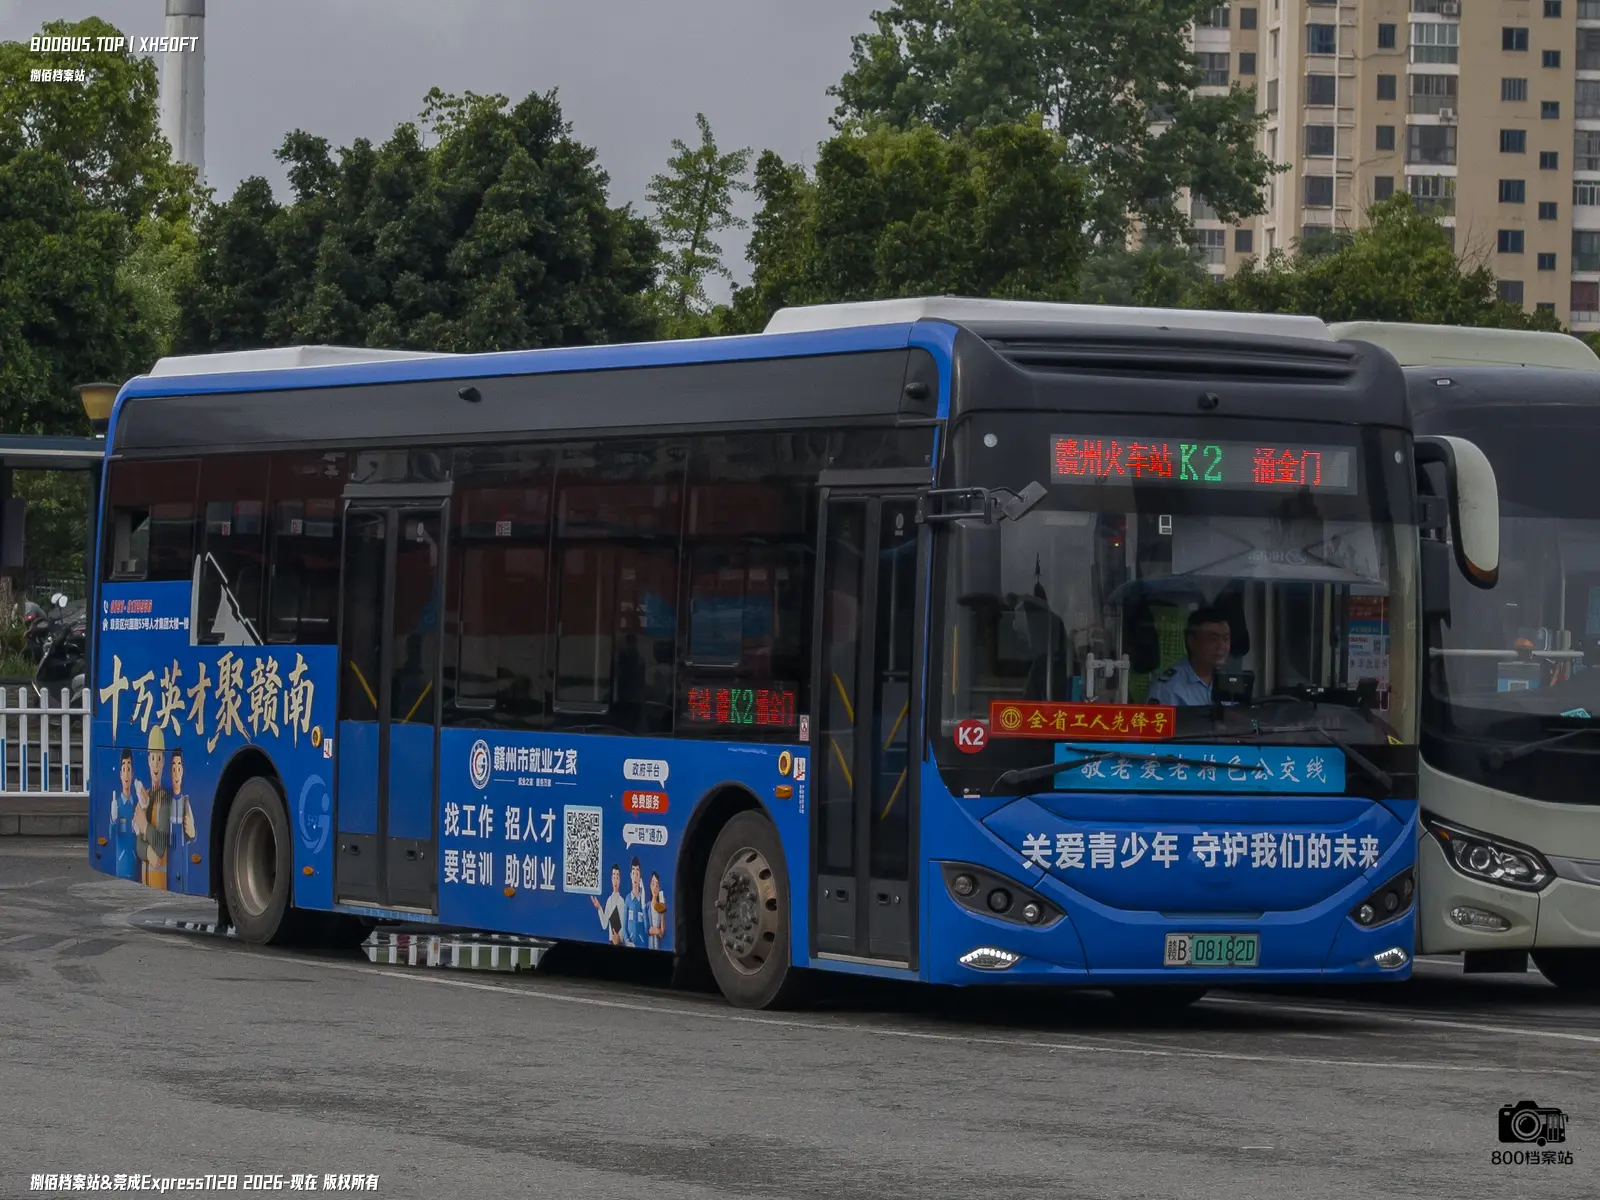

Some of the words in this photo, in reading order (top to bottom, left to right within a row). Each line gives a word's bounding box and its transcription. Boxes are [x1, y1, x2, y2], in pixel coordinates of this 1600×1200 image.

[1055, 438, 1172, 477] 赣州火车站
[1180, 444, 1222, 481] K2
[1253, 447, 1321, 485] 涌金门
[100, 651, 314, 753] 十万英才聚赣南
[731, 688, 753, 724] K2
[958, 726, 985, 746] K2
[1027, 709, 1168, 734] 全省工人先锋号
[494, 746, 578, 775] 赣州市就业之家
[632, 763, 660, 777] 政府平台
[631, 794, 660, 810] 免费服务
[444, 802, 494, 838] 找工作
[505, 805, 556, 842] 招人才
[1022, 832, 1179, 869] 关爱青少年
[1192, 832, 1379, 869] 守护我们的未来
[444, 850, 493, 886] 要培训
[505, 854, 555, 890] 助创业
